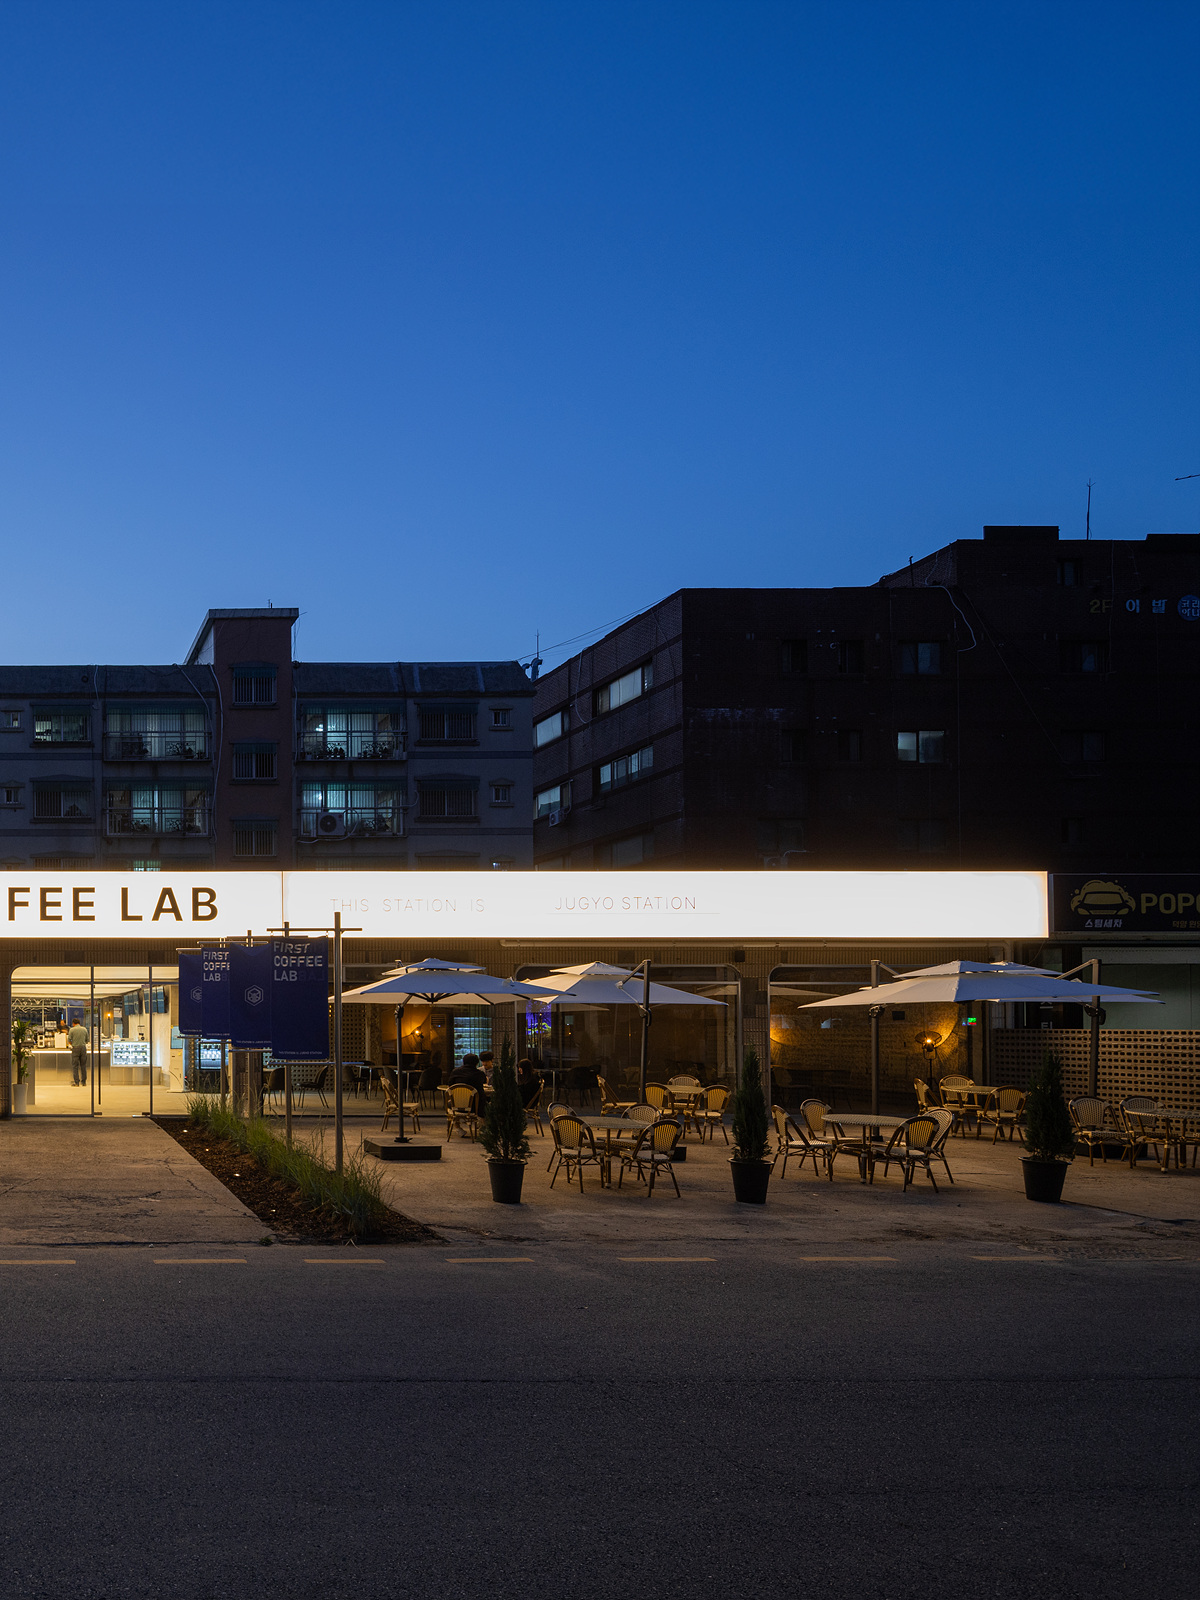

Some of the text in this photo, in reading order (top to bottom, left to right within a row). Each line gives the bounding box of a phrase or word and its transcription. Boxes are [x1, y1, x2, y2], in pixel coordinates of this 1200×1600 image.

[1090, 599, 1111, 613] 2F
[120, 886, 219, 922] LAB
[329, 898, 486, 912] THIS STATION IS
[554, 896, 698, 911] JUGYO STATION
[1140, 892, 1200, 914] POP
[273, 941, 311, 954] FIRST
[203, 951, 230, 961] FIRST
[273, 955, 323, 967] COFFEE
[203, 961, 230, 971] COFFE
[203, 972, 221, 982] LAB
[273, 969, 298, 982] LAB
